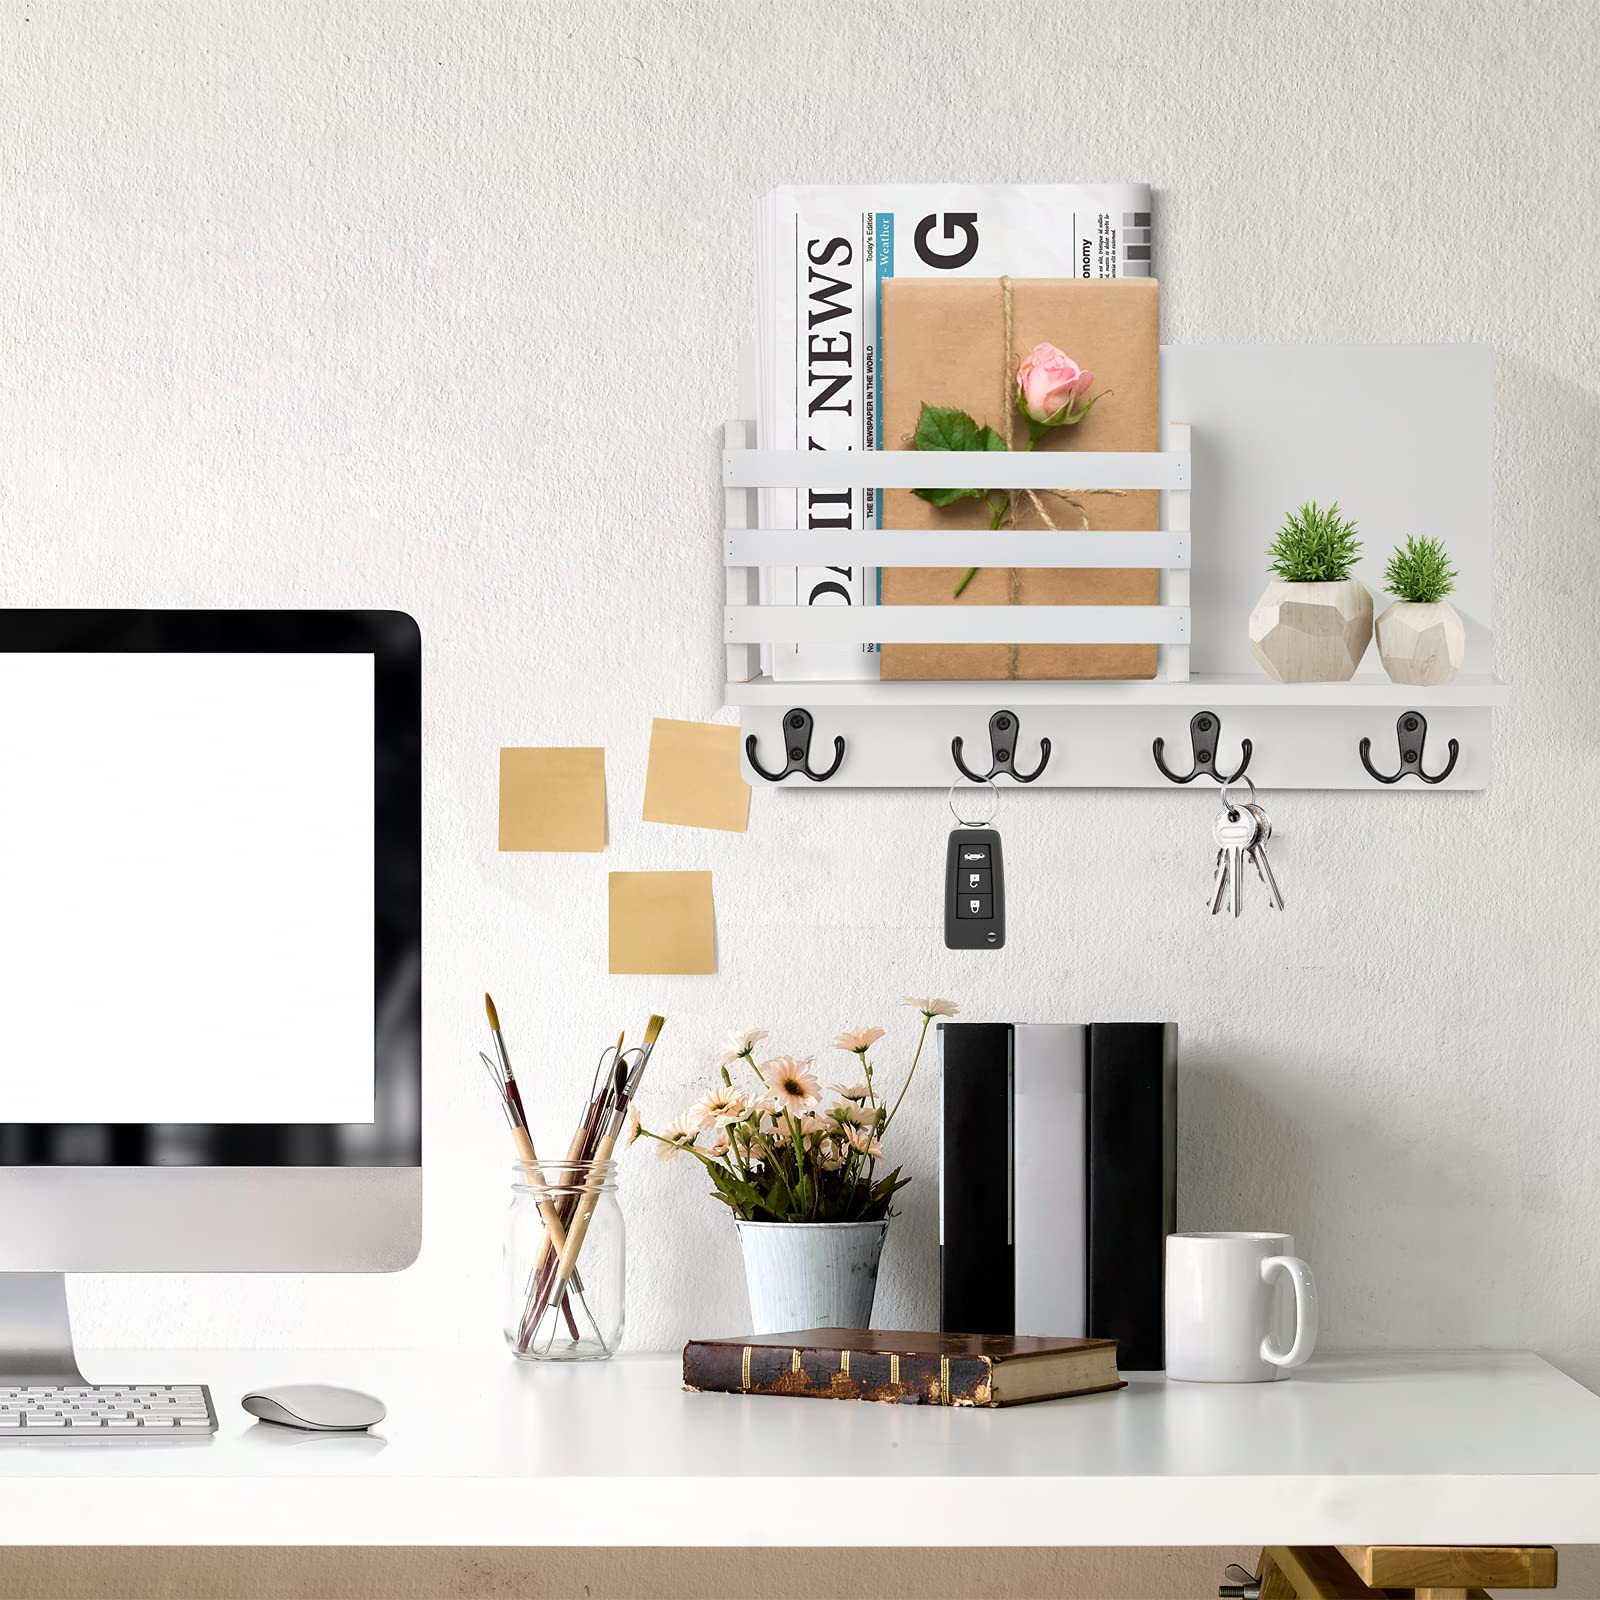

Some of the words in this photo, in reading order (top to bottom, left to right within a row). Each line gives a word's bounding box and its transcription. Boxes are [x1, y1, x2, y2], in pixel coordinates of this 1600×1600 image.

[866, 237, 874, 262] Today's
[880, 218, 890, 266] Weather
[914, 212, 979, 270] G
[1083, 239, 1092, 278] onomy
[807, 237, 852, 418] NEWS
